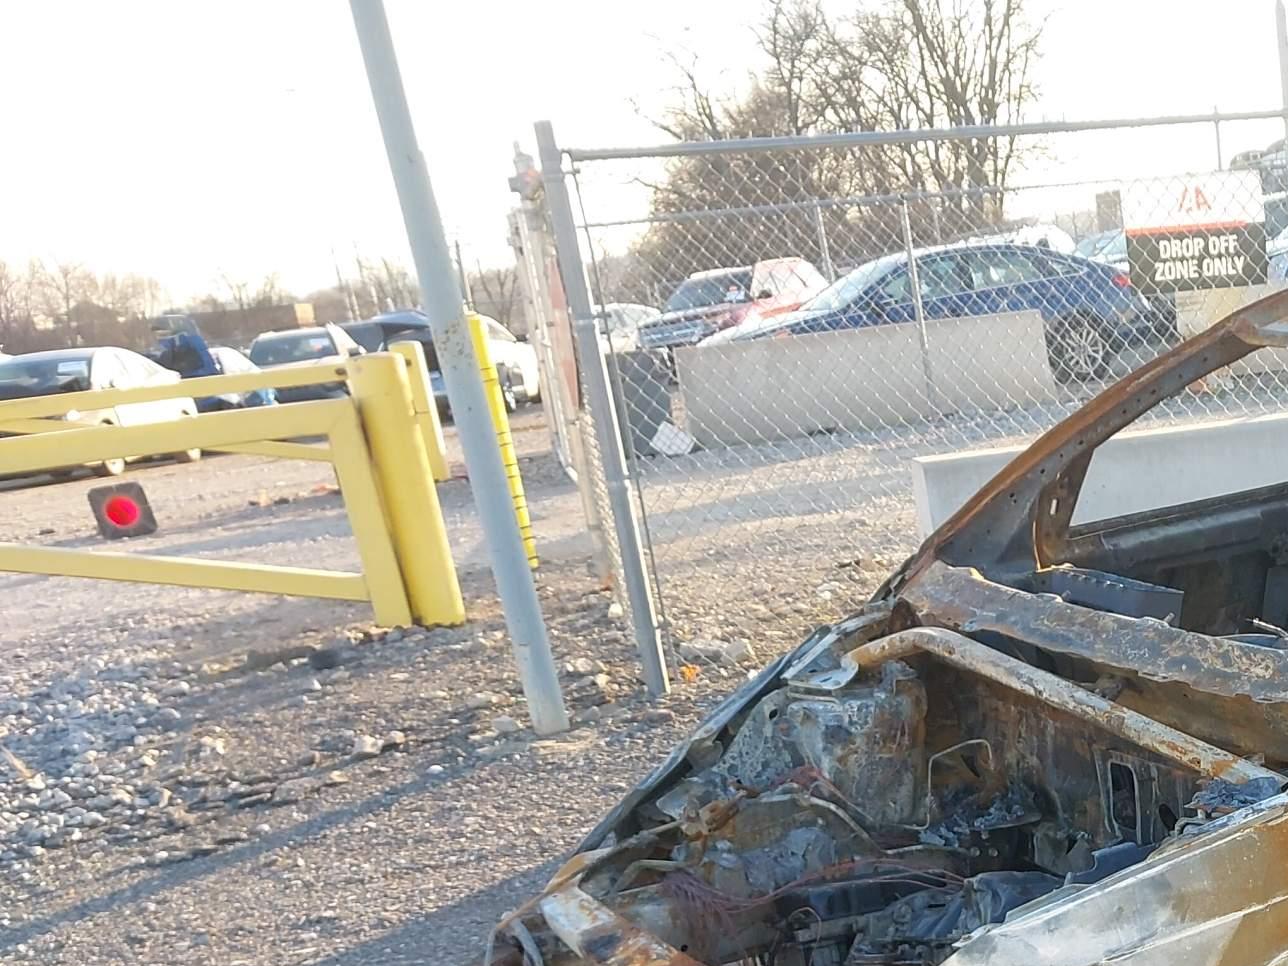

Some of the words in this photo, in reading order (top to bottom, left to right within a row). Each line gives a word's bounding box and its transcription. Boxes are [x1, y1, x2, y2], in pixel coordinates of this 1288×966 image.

[1159, 237, 1204, 259] DROP
[1208, 234, 1238, 255] OFF
[1155, 259, 1199, 281] ZONE
[1202, 255, 1245, 277] ONLY
